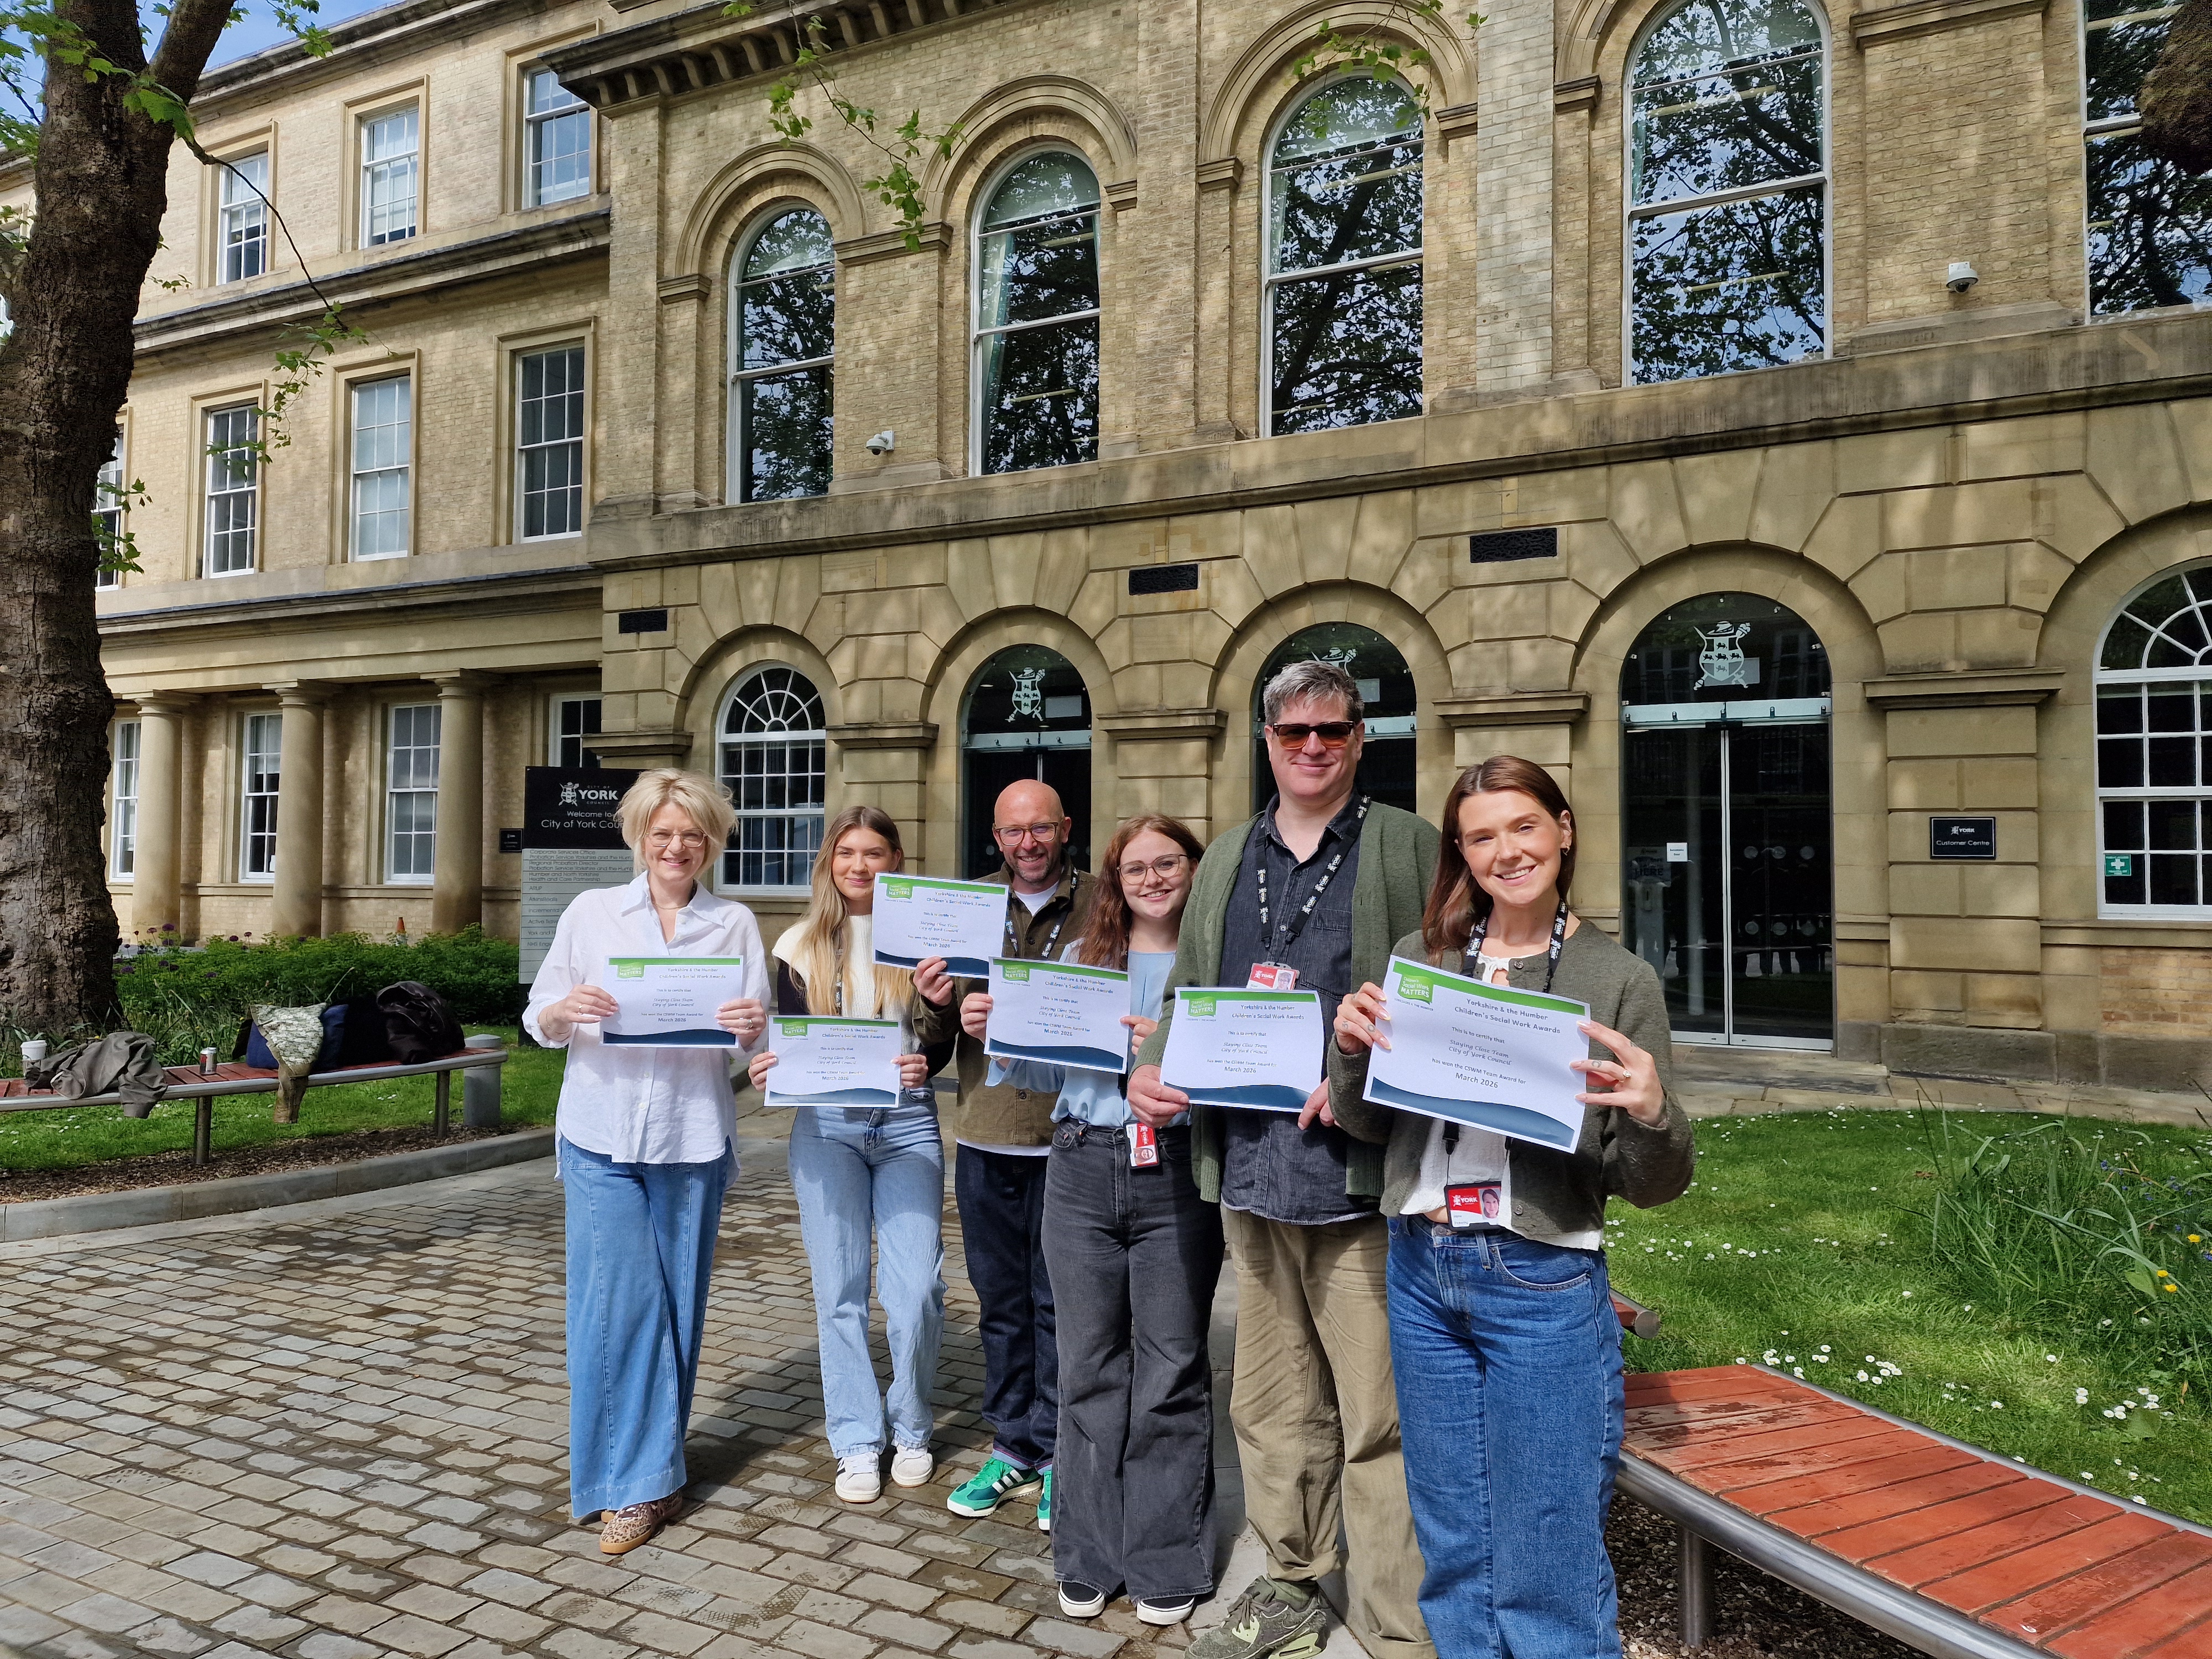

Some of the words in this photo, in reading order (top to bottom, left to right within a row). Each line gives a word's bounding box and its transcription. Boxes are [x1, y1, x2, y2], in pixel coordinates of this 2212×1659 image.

[578, 790, 619, 800] YORK
[541, 820, 561, 829] City
[564, 820, 573, 828] of
[576, 820, 596, 828] York
[1401, 986, 1430, 998] MATTERS
[1467, 999, 1498, 1011] Yorkshire
[1520, 1010, 1548, 1020] Humber
[1455, 1006, 1488, 1019] Children's
[1490, 1015, 1510, 1024] Social
[1512, 1020, 1531, 1028] Work
[1533, 1024, 1560, 1034] Awards
[1449, 1040, 1473, 1050] Staying
[1449, 1046, 1462, 1055] City
[1470, 1050, 1485, 1059] York
[1488, 1056, 1512, 1065] Council
[1455, 1072, 1478, 1083] March
[1480, 1078, 1498, 1088] 2026
